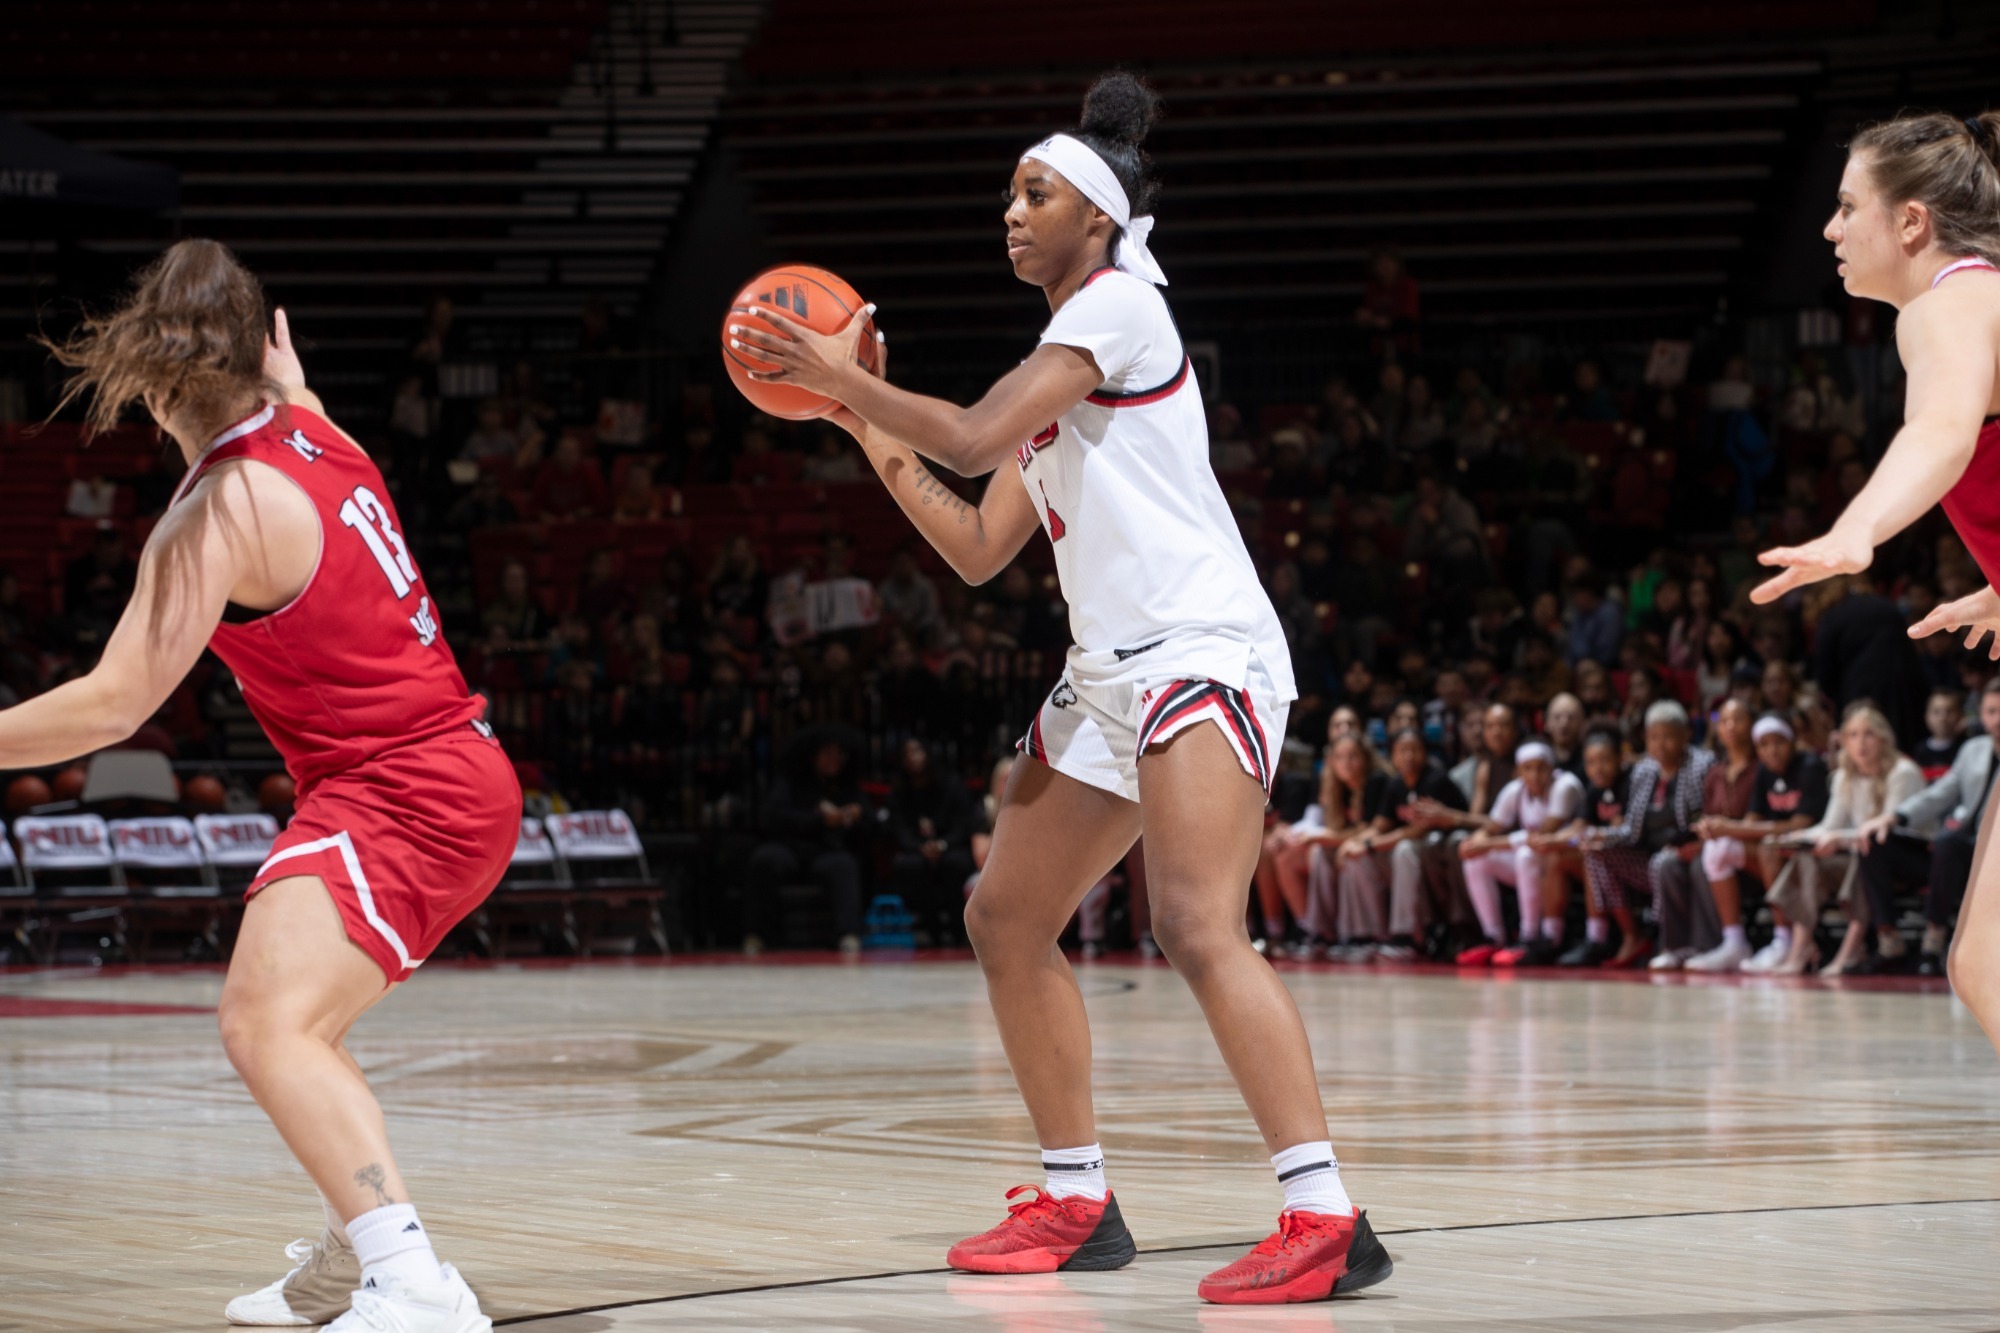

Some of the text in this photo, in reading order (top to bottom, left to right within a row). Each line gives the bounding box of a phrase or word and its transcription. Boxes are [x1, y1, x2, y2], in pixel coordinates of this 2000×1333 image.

[338, 484, 418, 600] 13
[27, 825, 102, 846] NIU
[118, 825, 191, 846] NIU
[560, 814, 629, 836] NIU
